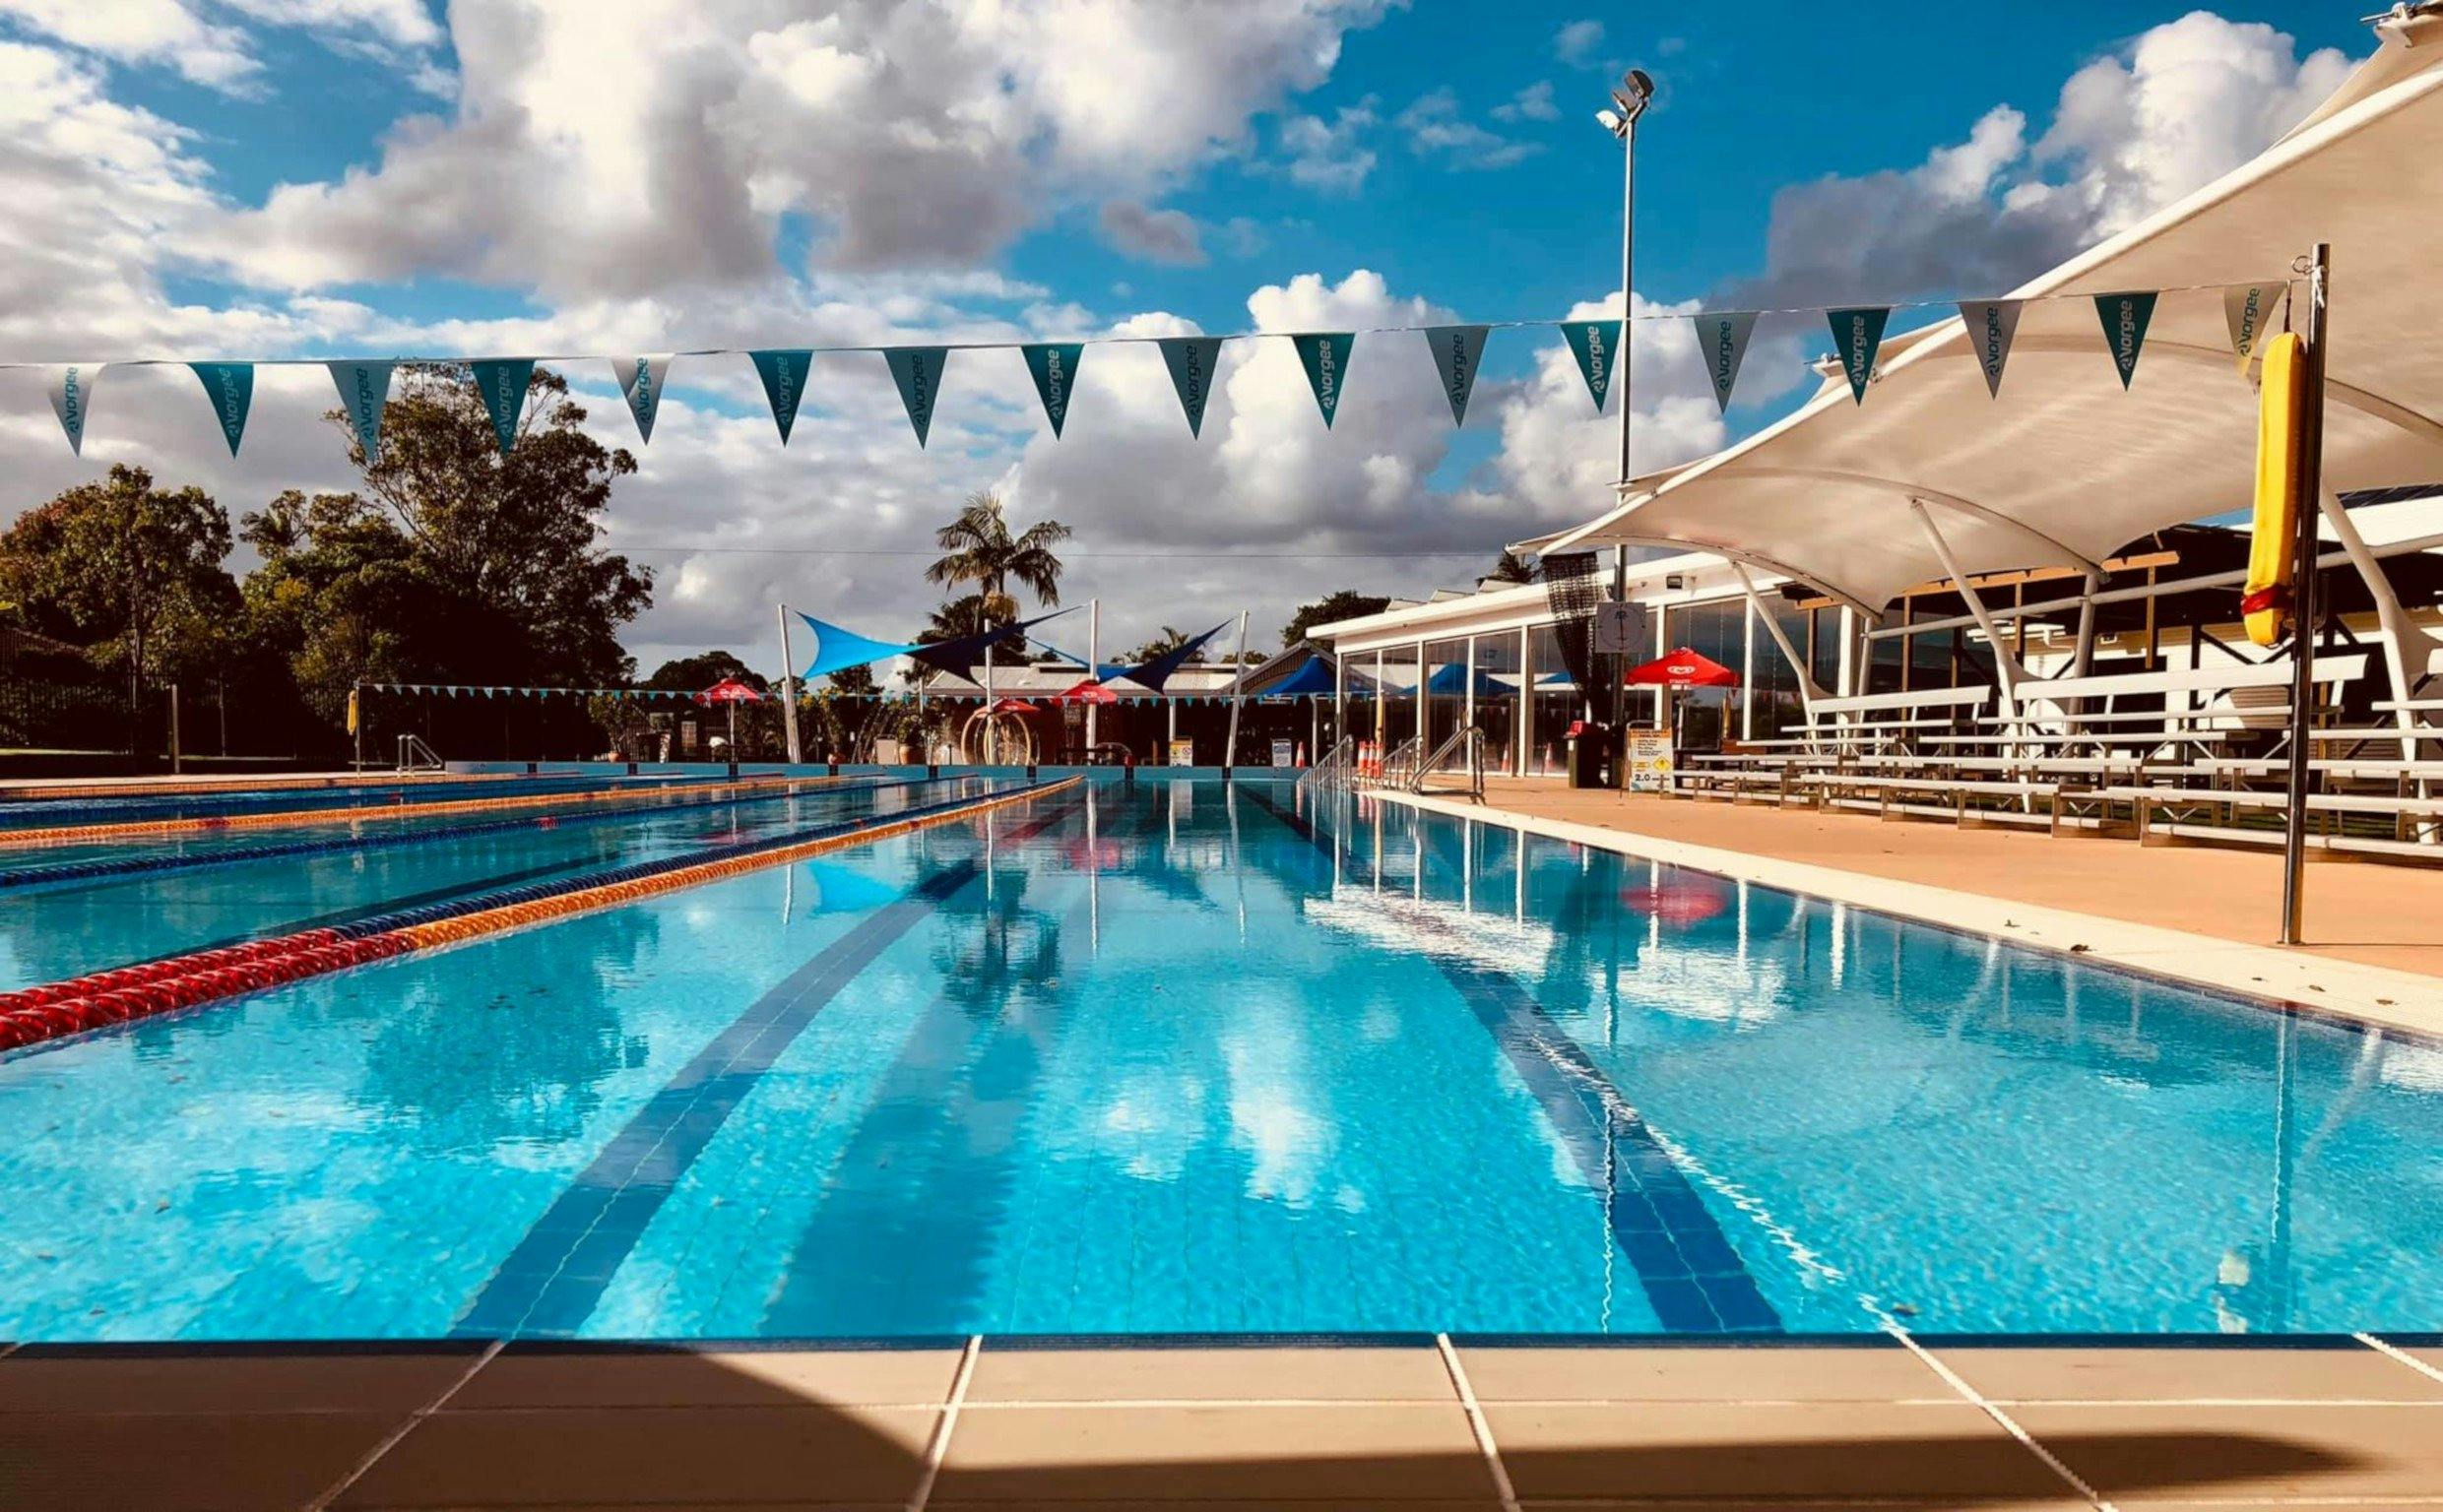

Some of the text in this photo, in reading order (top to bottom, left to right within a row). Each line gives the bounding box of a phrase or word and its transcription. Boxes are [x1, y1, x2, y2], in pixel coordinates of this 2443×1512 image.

[1852, 315, 1867, 370] vorgee
[1987, 307, 2001, 364] vorgee
[2120, 299, 2136, 356] vorgee
[2240, 288, 2260, 342] vorgee
[1189, 346, 1203, 408] vorgee
[1318, 340, 1334, 400] vorgee
[1453, 334, 1466, 393] vorgee
[1588, 326, 1603, 382] vorgee
[1719, 321, 1732, 378] vorgee
[65, 367, 79, 426] vorgee
[360, 368, 375, 432] vorgee
[496, 366, 511, 426] vorgee
[637, 357, 653, 410] vorgee
[912, 354, 927, 417] vorgee
[1047, 349, 1062, 410] vorgee
